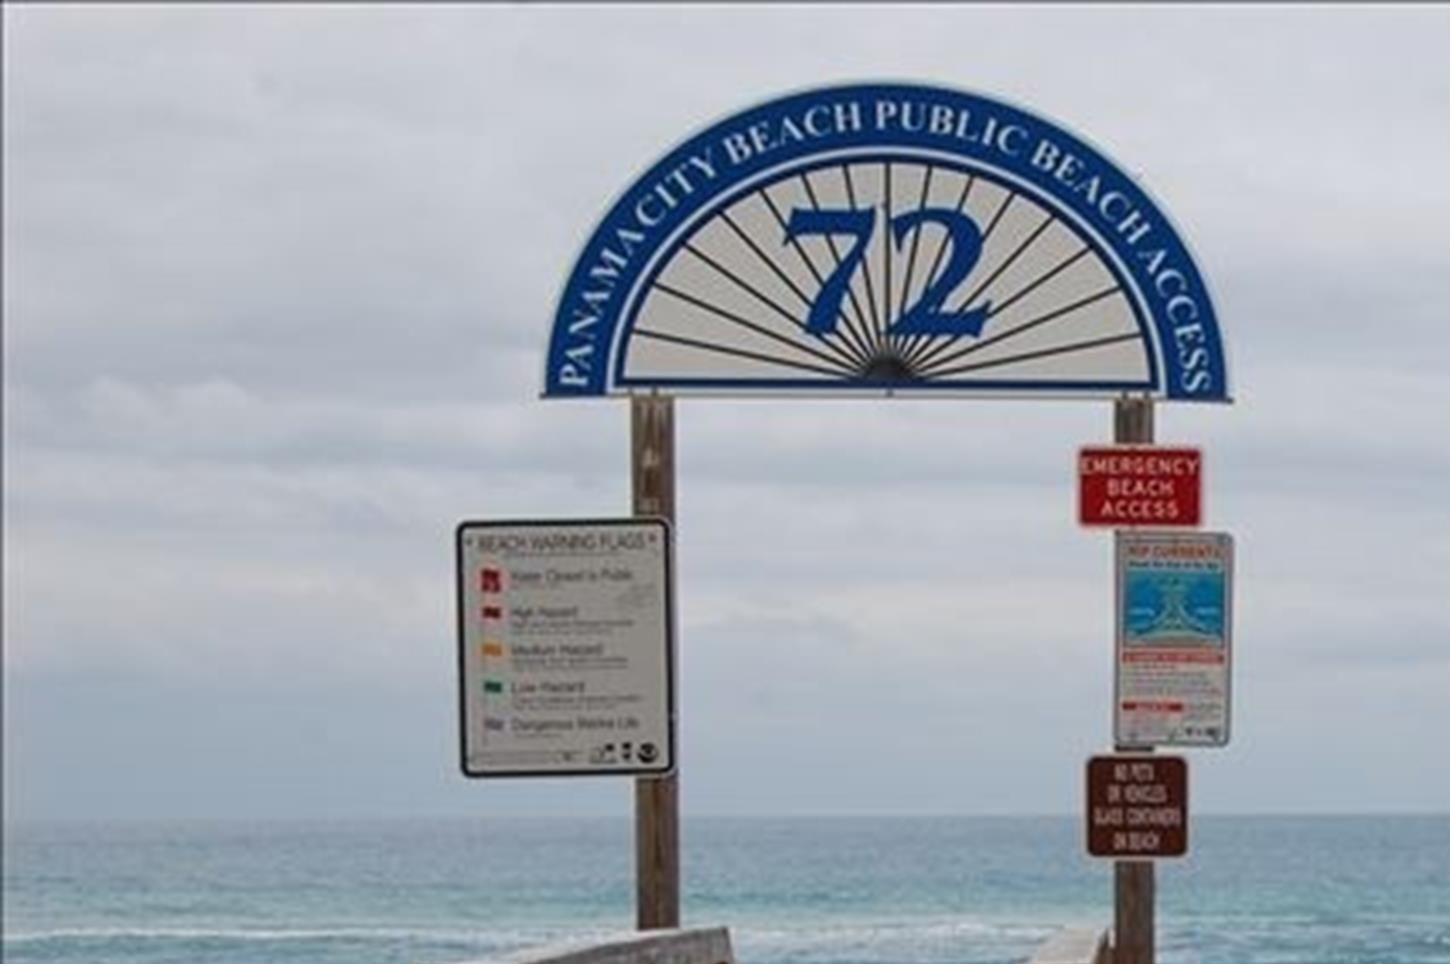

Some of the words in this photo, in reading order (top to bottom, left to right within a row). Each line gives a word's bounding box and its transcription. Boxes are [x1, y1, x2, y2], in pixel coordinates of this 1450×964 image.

[559, 229, 646, 387] PANAMA
[634, 154, 716, 229] CITY
[724, 103, 862, 166] BEACH
[875, 102, 1021, 155] PUBLIC
[1031, 139, 1151, 246] BEACH
[1137, 246, 1211, 394] ACCESS
[782, 205, 993, 337] 72
[1081, 456, 1198, 475] EMERGENCY
[1106, 478, 1175, 497] BEACH
[1100, 500, 1179, 518] ACCESS
[530, 533, 595, 551] WARNING
[599, 532, 646, 549] FLAGS
